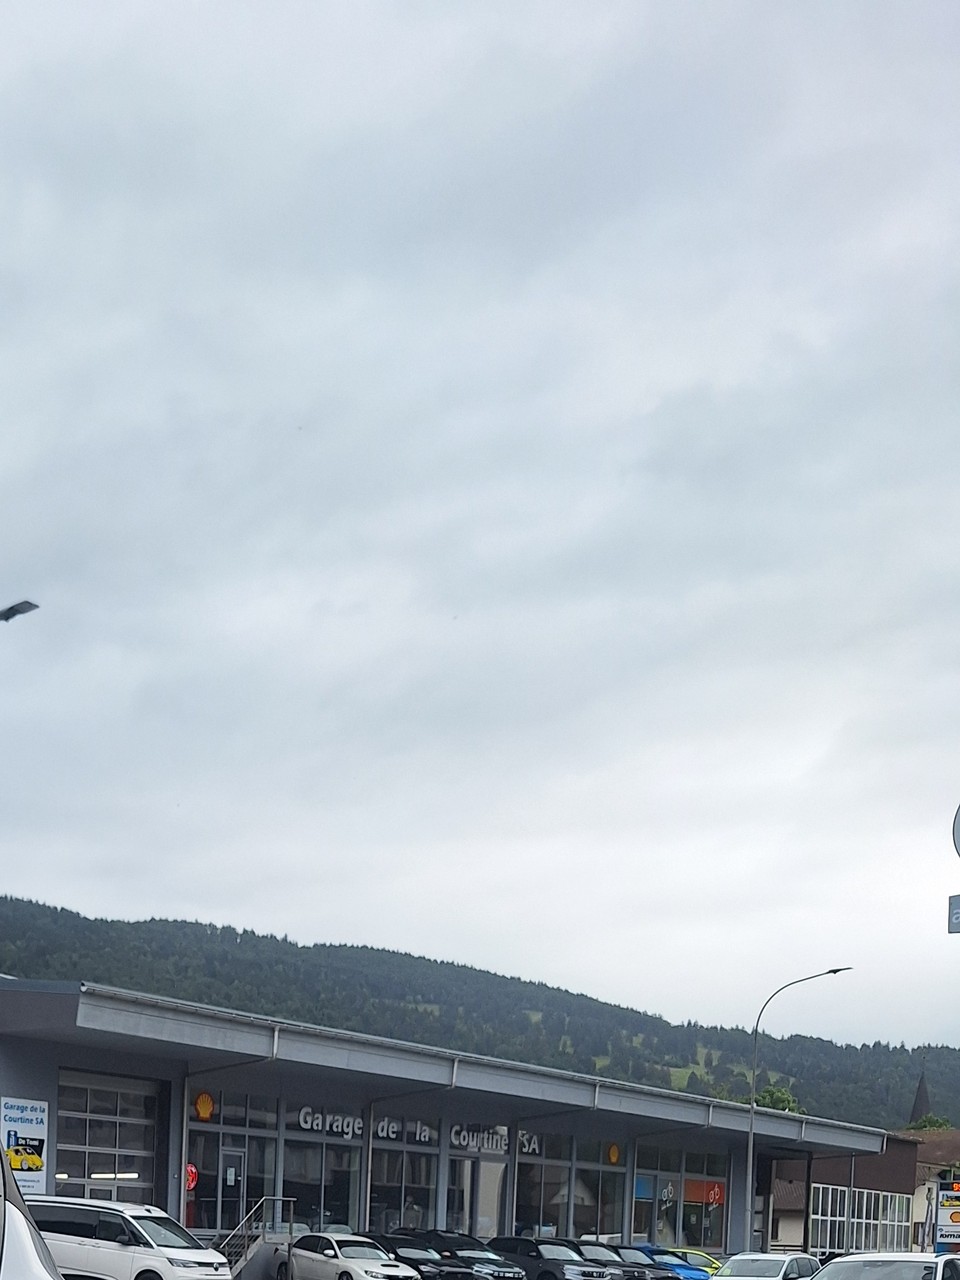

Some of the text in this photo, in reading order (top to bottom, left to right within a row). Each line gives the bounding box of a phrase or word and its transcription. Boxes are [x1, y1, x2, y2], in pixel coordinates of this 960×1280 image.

[3, 1102, 28, 1113] Garage
[29, 1105, 38, 1113] de
[3, 1114, 45, 1125] Courtine SA
[299, 1106, 540, 1154] Garage de la Courtine SA
